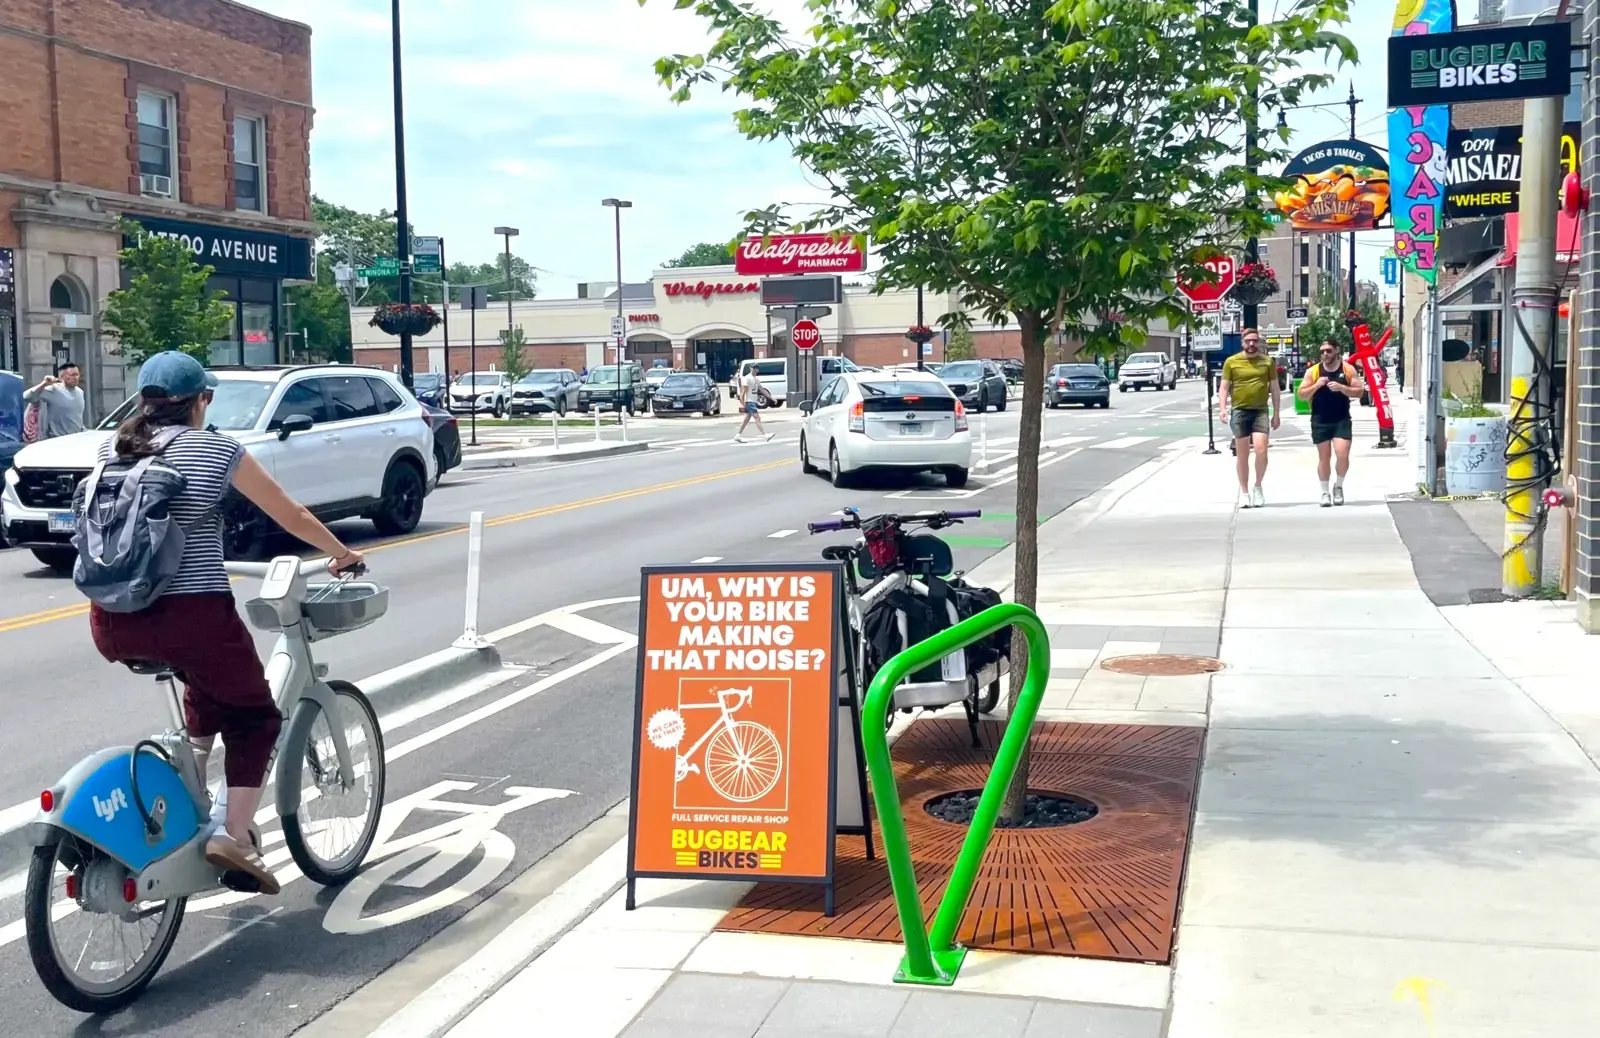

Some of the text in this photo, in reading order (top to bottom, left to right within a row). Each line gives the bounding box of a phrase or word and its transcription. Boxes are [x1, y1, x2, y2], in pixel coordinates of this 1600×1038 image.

[1411, 40, 1546, 71] BUGBEAR
[1439, 63, 1517, 89] BIKES
[1302, 149, 1325, 165] TACOS
[1333, 147, 1366, 162] TAMALES
[1462, 138, 1495, 153] DON
[1444, 154, 1522, 186] MISAEL
[210, 238, 278, 264] AVENUE
[740, 239, 857, 265] Walgreens
[797, 258, 848, 268] PHARMACY
[663, 281, 760, 300] Walgreen
[628, 314, 660, 322] PHOTO
[793, 328, 818, 340] STOP
[1367, 356, 1394, 420] OPEN
[661, 576, 816, 602] UM, WHY IS
[666, 600, 810, 622] YOUR BIKE
[678, 624, 795, 646] MAKING
[647, 648, 826, 671] THAT NOISE?
[663, 720, 678, 729] CAN
[92, 787, 128, 822] lyft
[671, 813, 789, 824] FULL SERVICE REPAIR SHOP
[671, 828, 787, 851] BUGBEAR
[699, 851, 758, 869] BIKES
